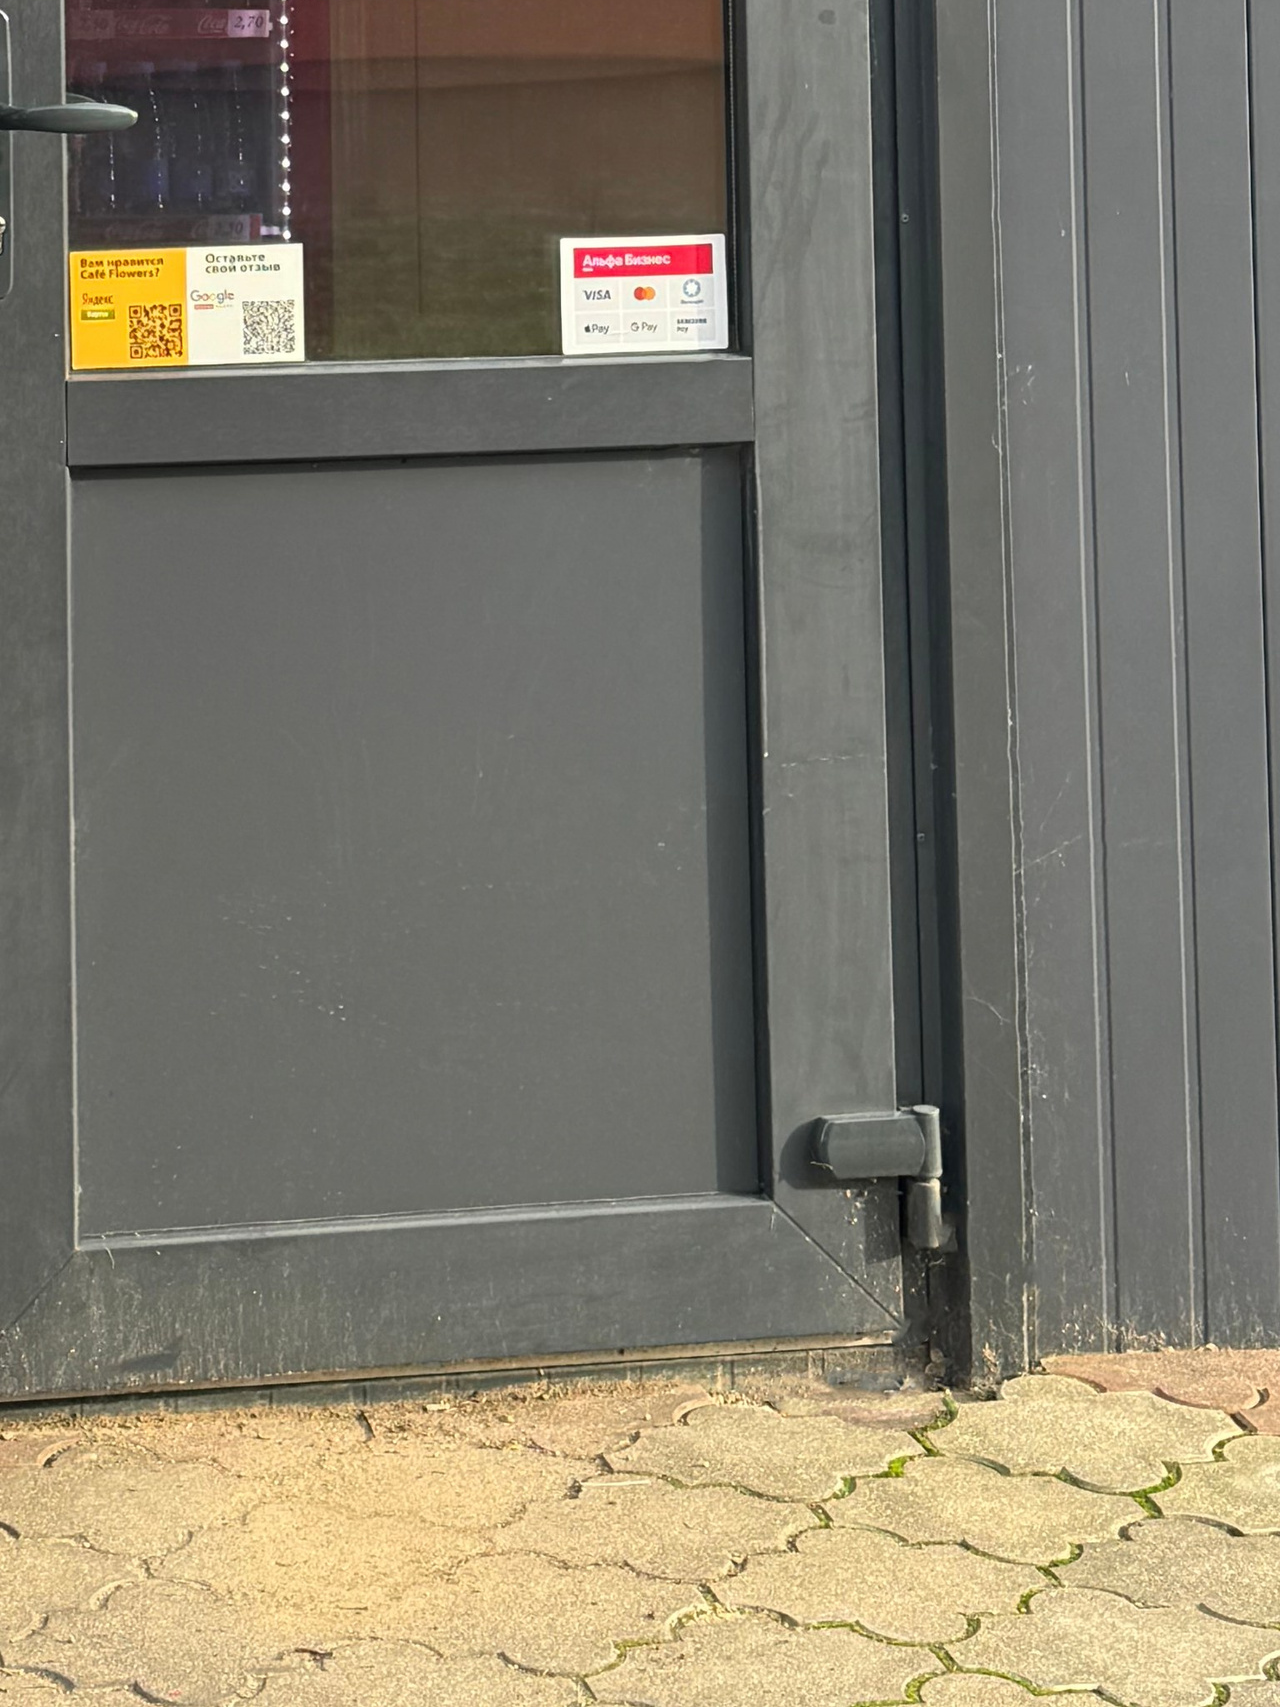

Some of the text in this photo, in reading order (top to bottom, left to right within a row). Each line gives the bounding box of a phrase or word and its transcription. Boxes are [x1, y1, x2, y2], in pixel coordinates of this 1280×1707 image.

[233, 14, 264, 30] 2,70
[80, 257, 164, 268] Вам нравится
[205, 253, 265, 263] Оставьте
[582, 253, 671, 269] Альфа Бизнес
[80, 268, 160, 279] Café Flowers?
[205, 263, 281, 274] свой отзыв
[82, 293, 114, 306] Яндекс
[190, 289, 235, 304] Google
[584, 289, 612, 301] VISA
[592, 323, 610, 335] Pay
[641, 321, 658, 333] Pay
